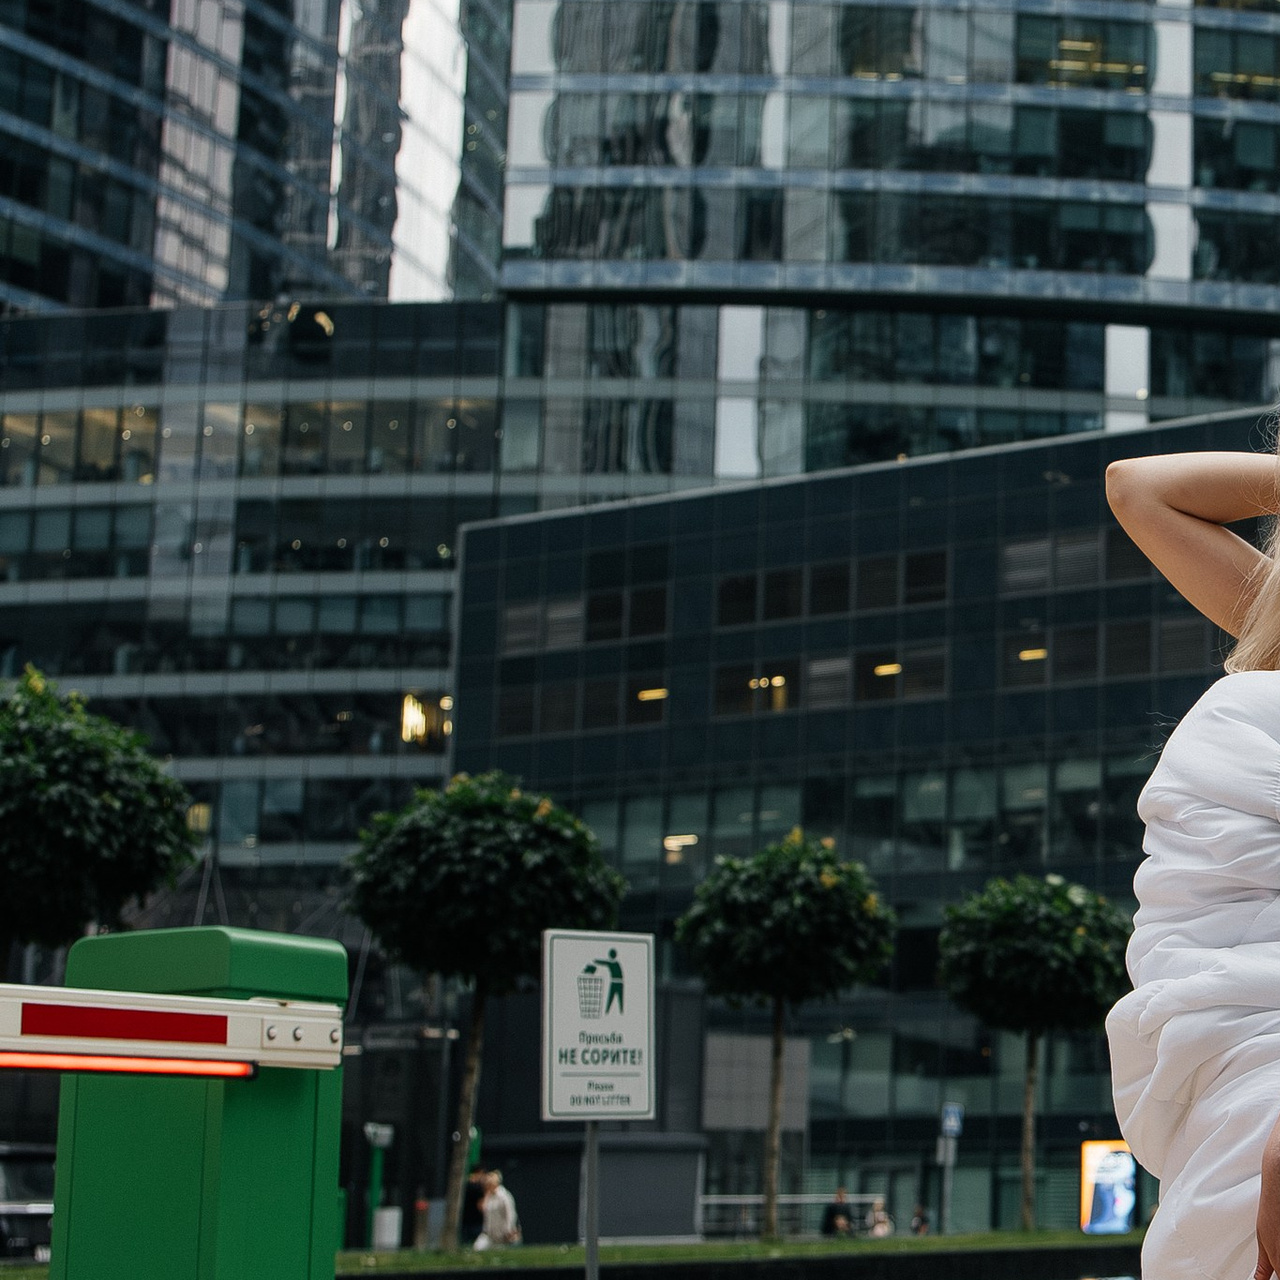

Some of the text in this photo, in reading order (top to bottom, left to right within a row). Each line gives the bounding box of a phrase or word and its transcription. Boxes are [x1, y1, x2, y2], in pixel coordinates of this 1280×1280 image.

[579, 1030, 623, 1045] Просьба
[558, 1048, 643, 1065] НЕ СОРИТЕ!
[587, 1081, 615, 1091] Please
[570, 1095, 581, 1106] DO
